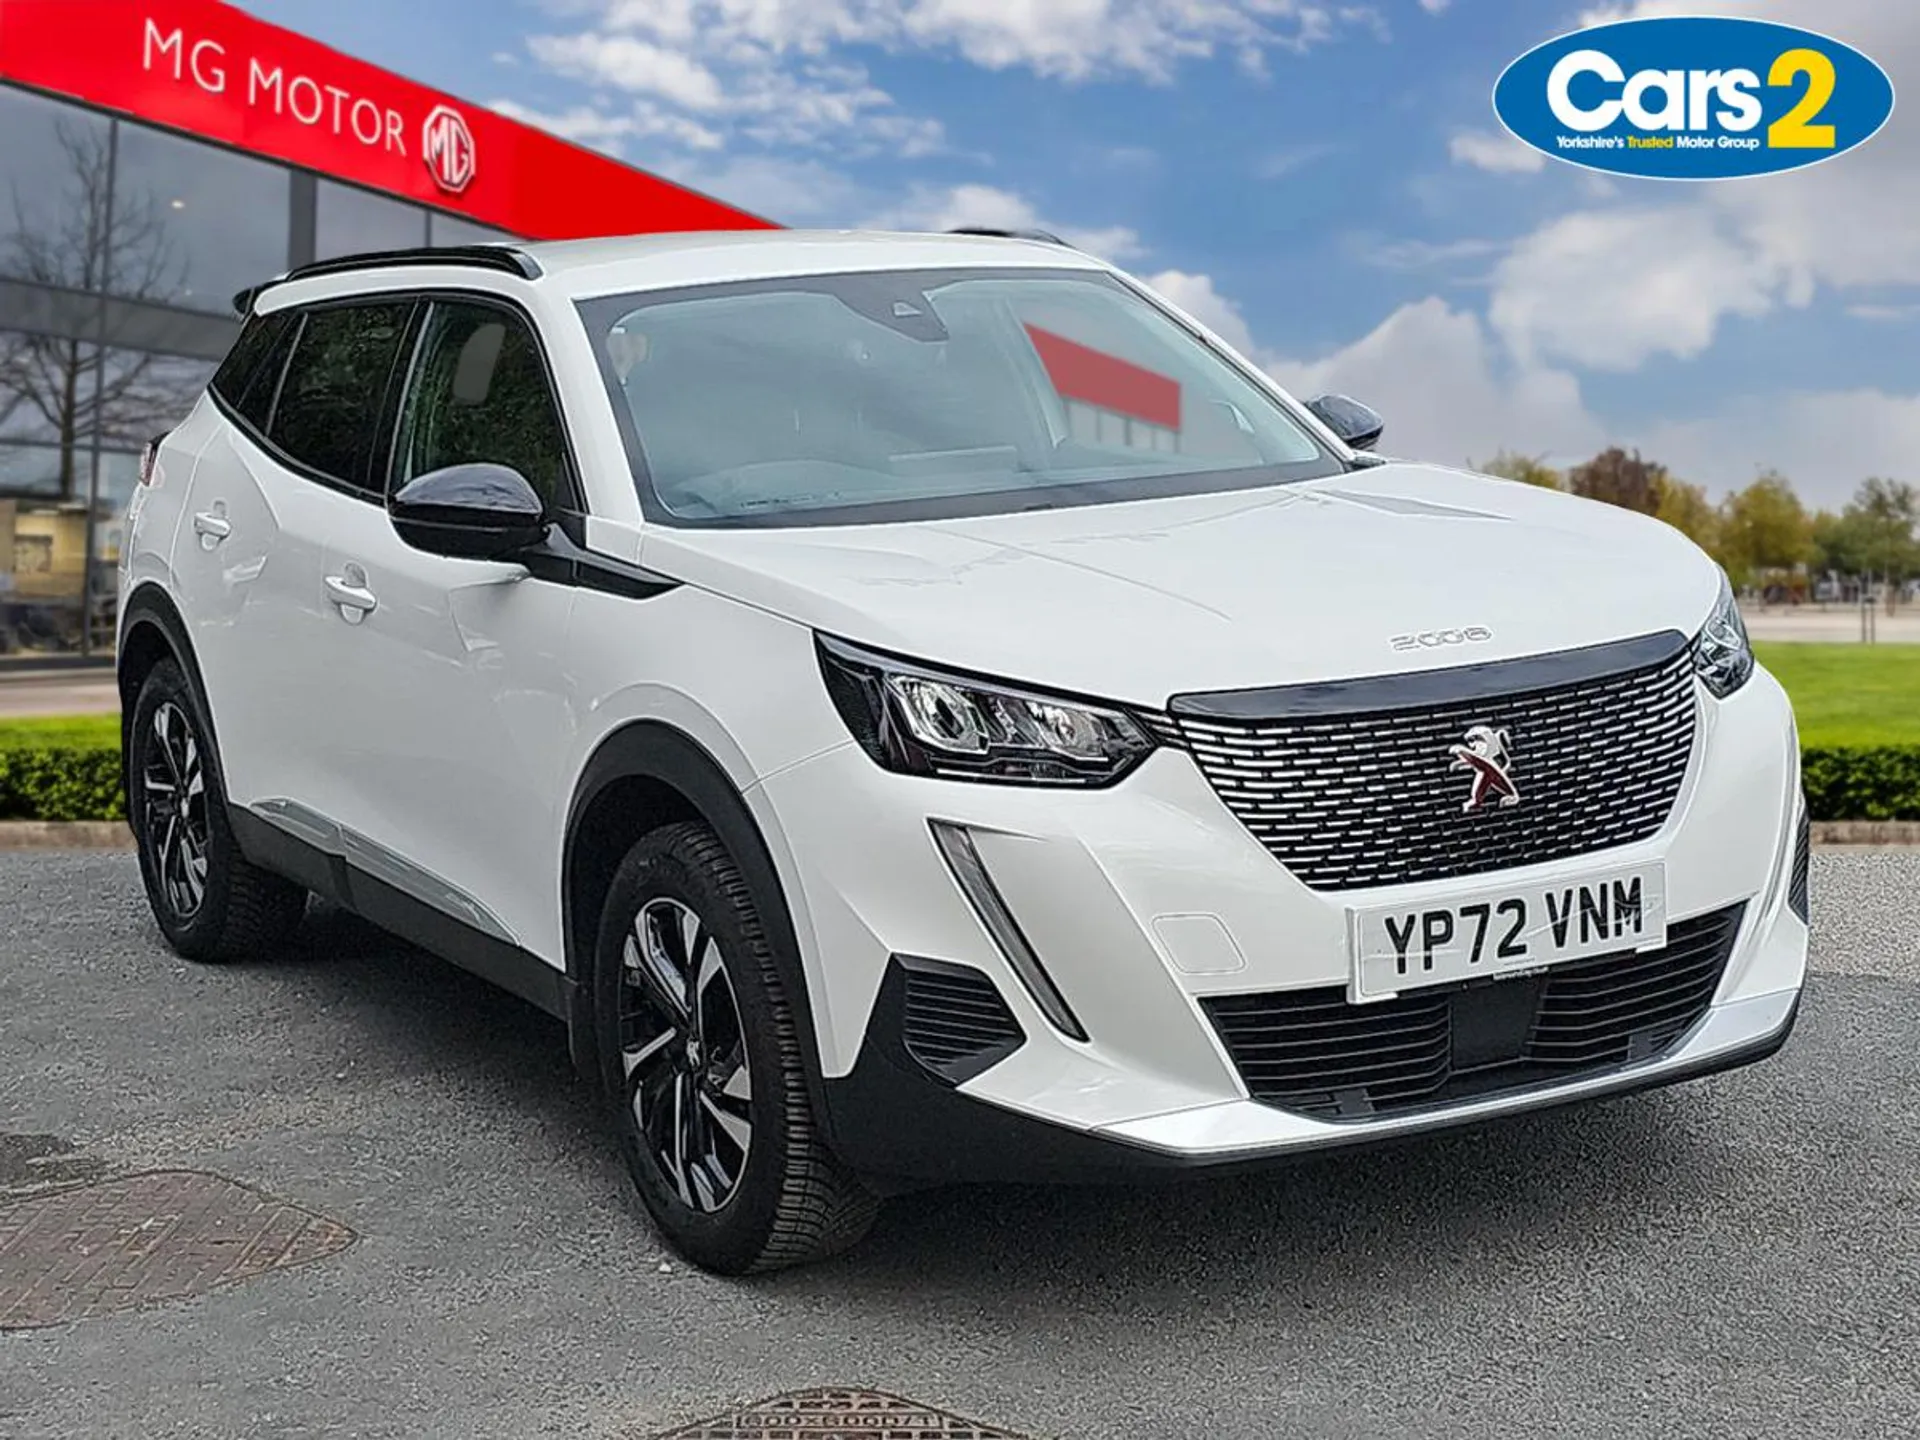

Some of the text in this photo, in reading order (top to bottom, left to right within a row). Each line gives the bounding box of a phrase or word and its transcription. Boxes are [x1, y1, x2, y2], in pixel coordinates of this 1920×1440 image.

[143, 17, 407, 157] MG MOTOR
[430, 115, 471, 187] MG
[1384, 876, 1642, 975] YP72 VNM
